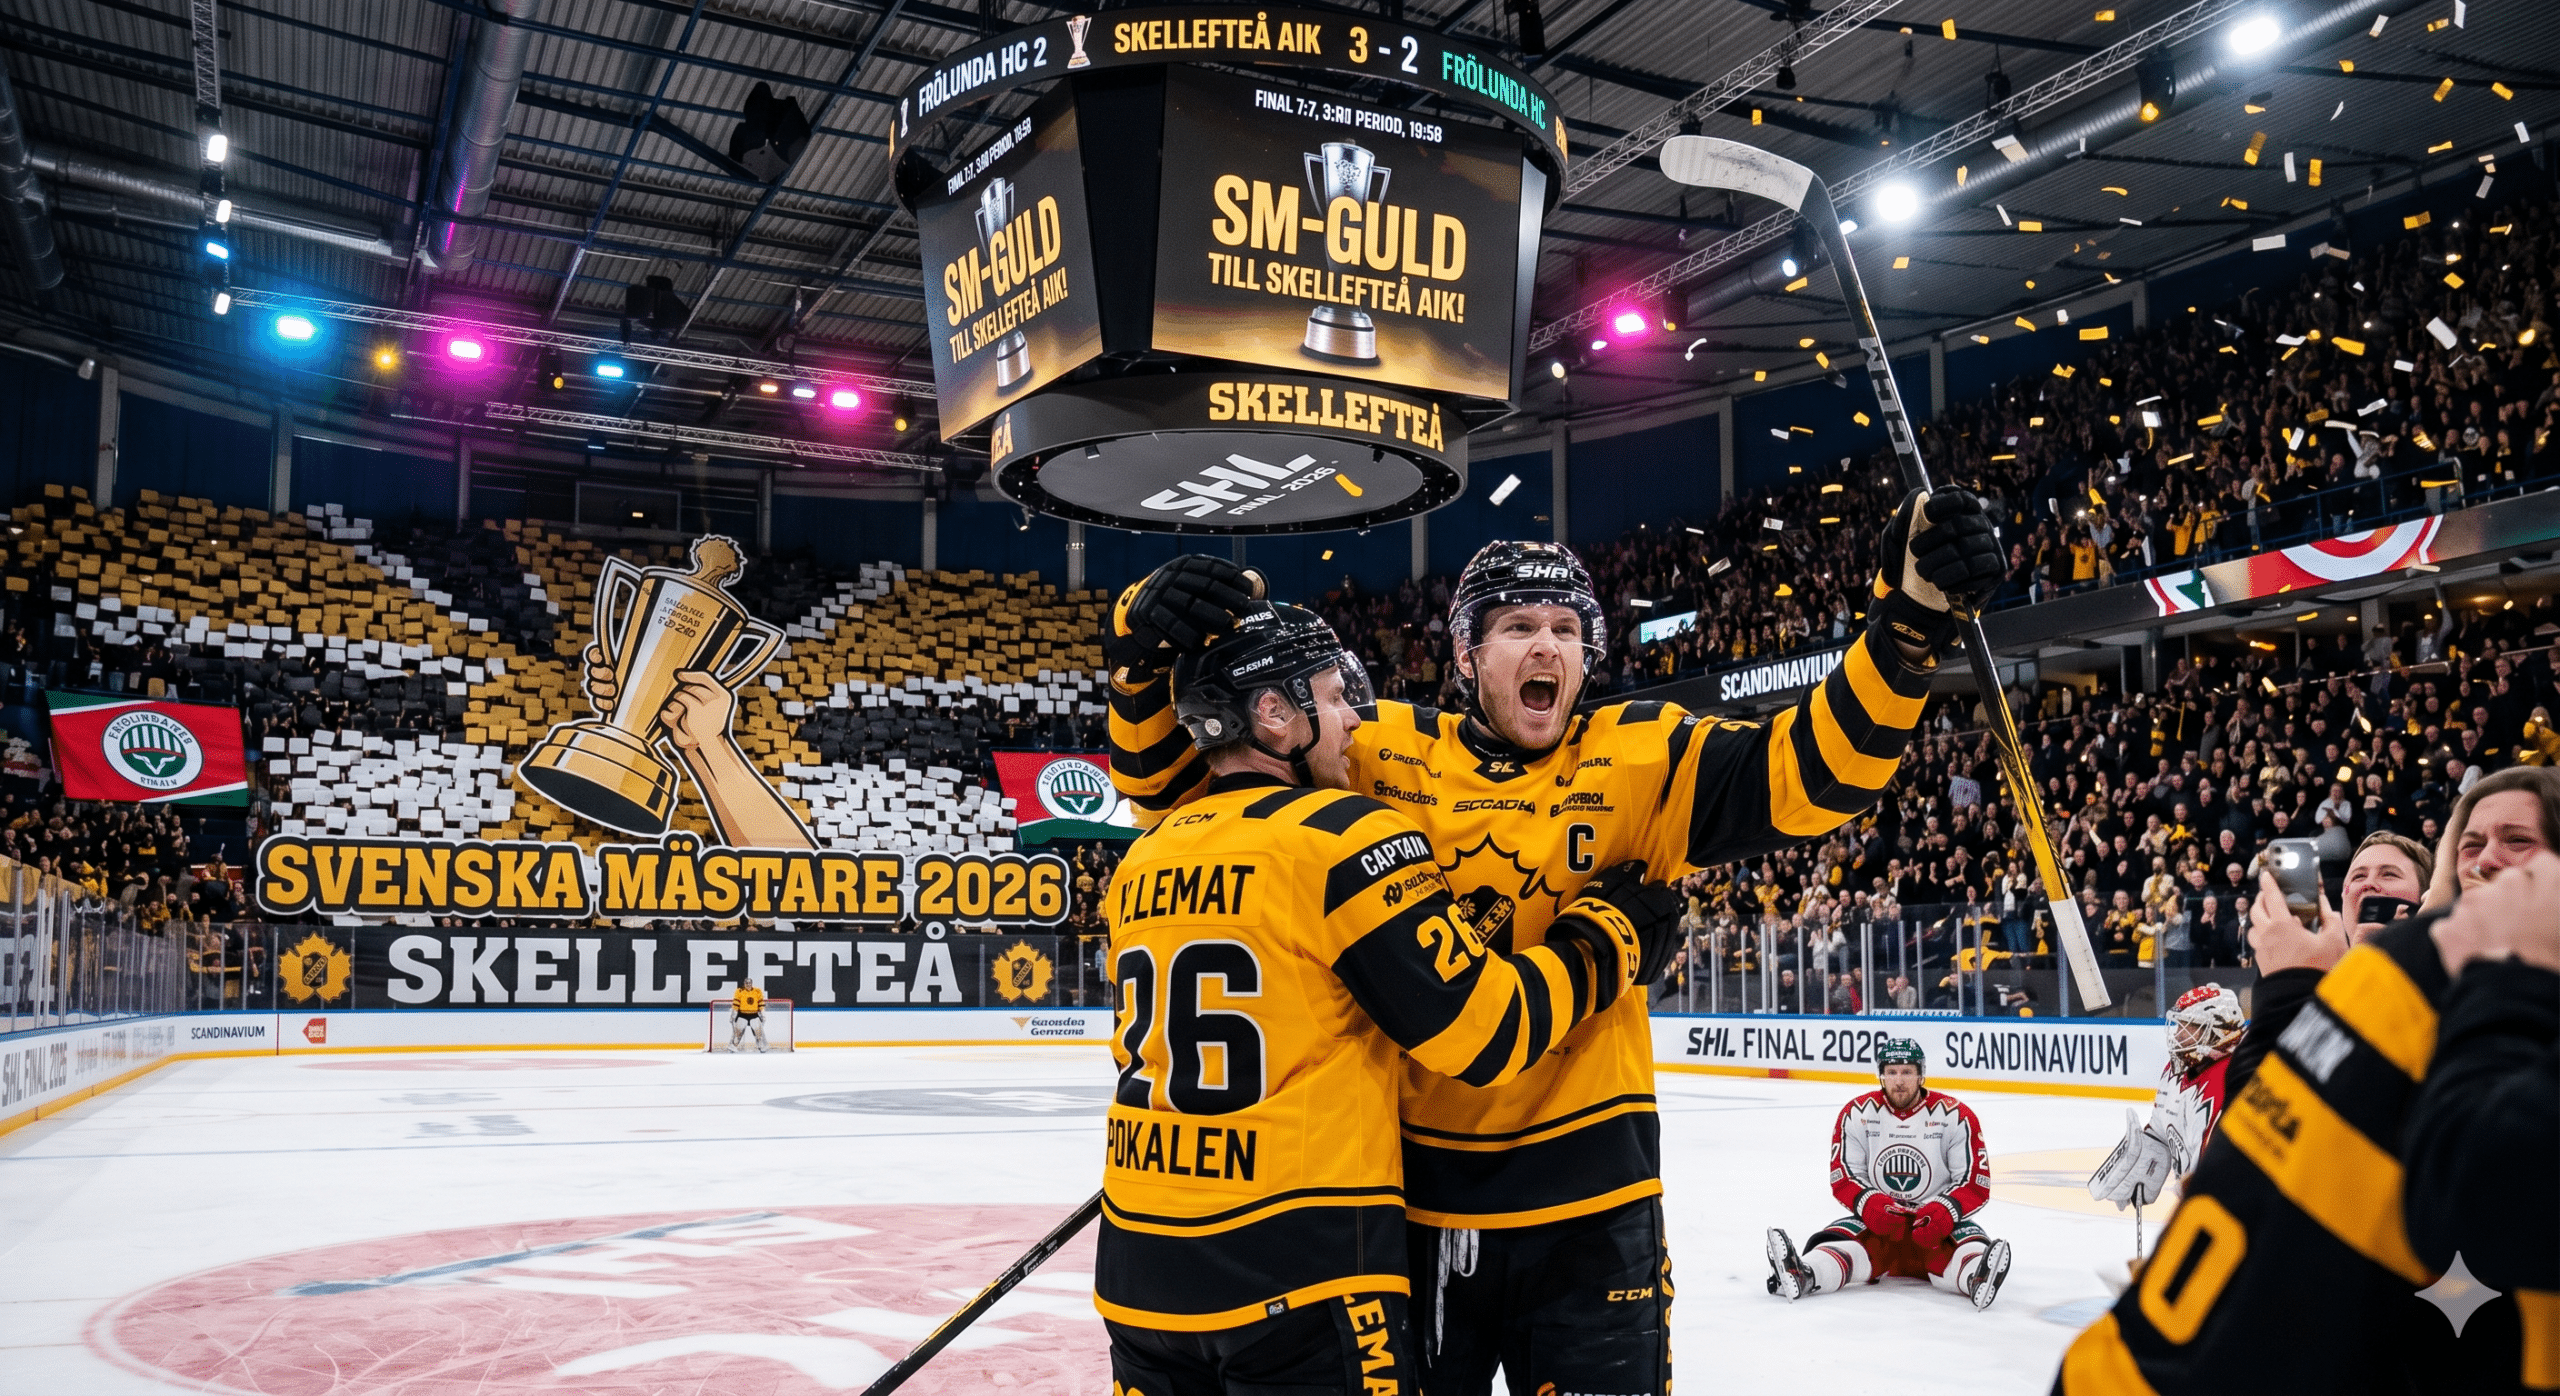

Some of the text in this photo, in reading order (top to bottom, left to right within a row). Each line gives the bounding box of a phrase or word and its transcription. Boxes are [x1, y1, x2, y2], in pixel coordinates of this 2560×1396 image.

[1001, 40, 1028, 77] HC
[1033, 37, 1047, 66] 2
[1114, 12, 1271, 53] SKELLEFTEÅ
[1278, 22, 1322, 54] AIK
[1349, 26, 1368, 63] 3
[1401, 35, 1418, 74] 2
[1255, 89, 1293, 113] FINAL
[1296, 98, 1319, 121] 7:7,
[1355, 109, 1406, 138] PERIOD,
[1409, 121, 1443, 143] 19:58
[1442, 50, 1547, 130] FRÖLUNDA HC
[1212, 174, 1467, 281] SM-GULD
[944, 195, 1061, 327] SM-GULD
[1208, 252, 1465, 324] TILL SKELLEFTEÅ AIK!
[949, 266, 1069, 364] TILL SKELLEFTEÅ AIK!
[1209, 382, 1444, 452] SKELLEFTEÅ
[1141, 454, 1317, 518] SHL
[1227, 467, 1336, 516] FINAL 2026
[1720, 650, 1843, 701] SCANDINAVIUM
[1173, 812, 1218, 828] CCM
[1567, 823, 1595, 873] C
[266, 840, 1062, 917] SVENSKA MÄSTARE 2026
[1360, 835, 1429, 876] CAPTAIN
[387, 922, 963, 1004] SKELLEFTEÅ
[190, 1025, 266, 1040] SCANDINAVIUM
[1116, 938, 1267, 1117] 26
[1686, 1026, 1889, 1066] SHL FINAL 2026
[1945, 1031, 2129, 1076] SCANDINAVIUM
[1106, 1117, 1258, 1183] POKALEN
[1607, 1286, 1654, 1302] CCM
